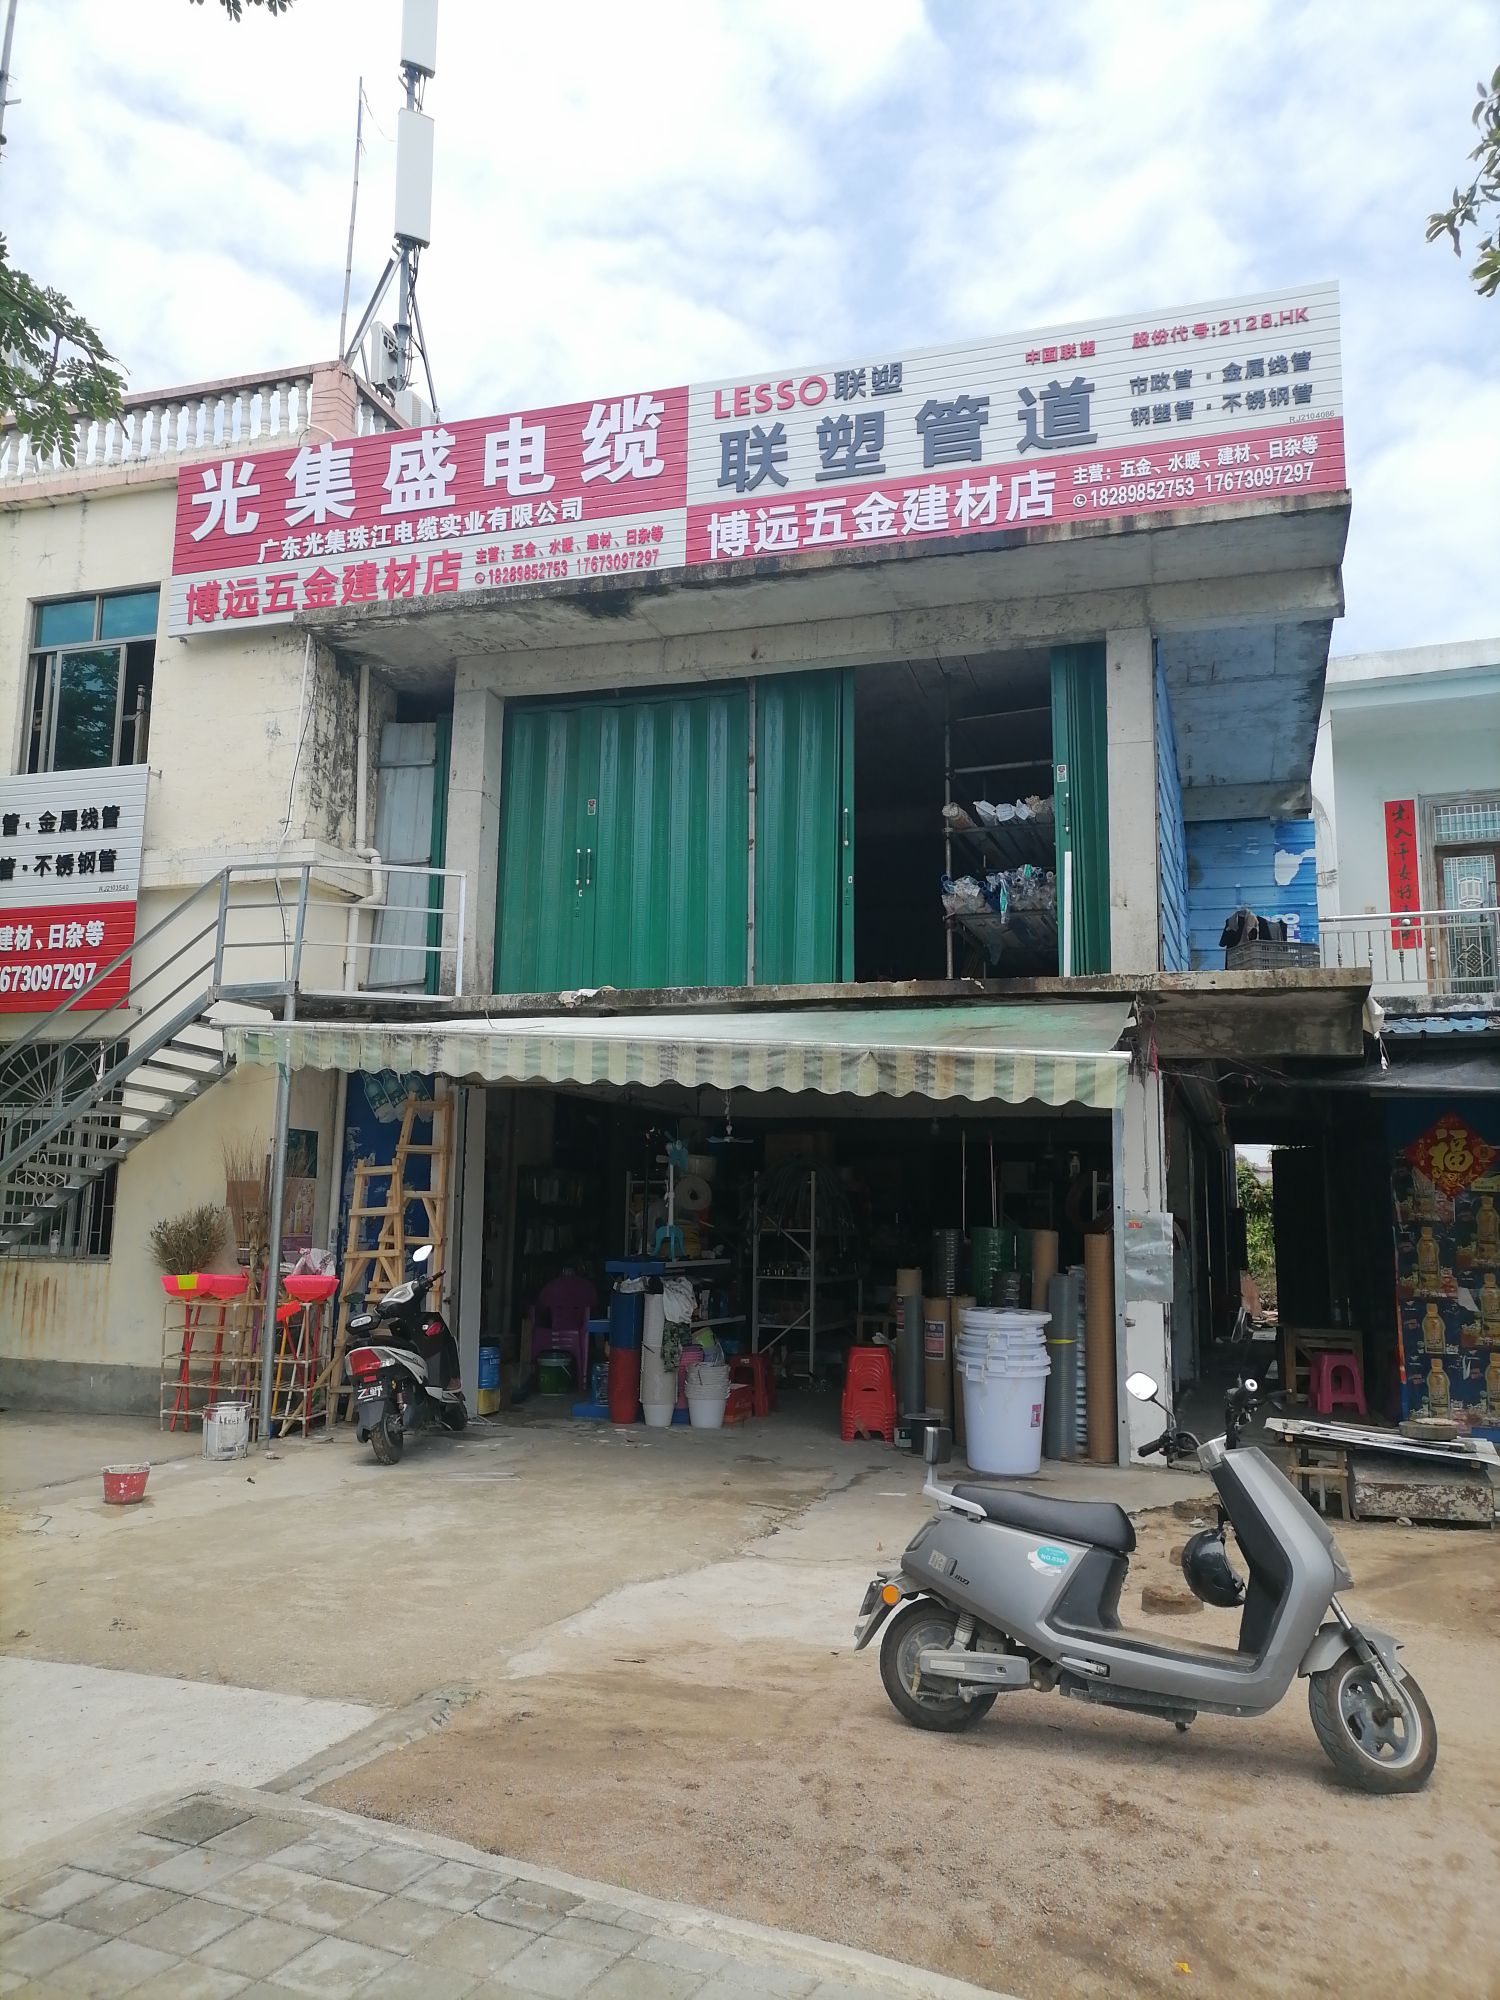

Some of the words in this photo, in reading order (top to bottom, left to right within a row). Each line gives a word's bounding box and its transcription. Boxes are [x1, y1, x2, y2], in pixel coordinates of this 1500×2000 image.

[1025, 340, 1096, 365] 中国联塑
[714, 375, 828, 420] LESSO
[833, 362, 903, 401] 联塑
[717, 376, 1099, 493] 联塑管道
[190, 394, 666, 542] 光集盛电缆
[1091, 477, 1195, 507] 18289852753
[1205, 462, 1315, 495] 17673097297
[257, 496, 583, 564] 广东光集珠江电缆实业有限公司
[706, 469, 1057, 560] 博远五金建材店
[185, 550, 463, 626] 博远五金建材店
[488, 560, 568, 585] 18289852753
[576, 549, 660, 575] 17673097297
[0, 962, 97, 993] 673097297
